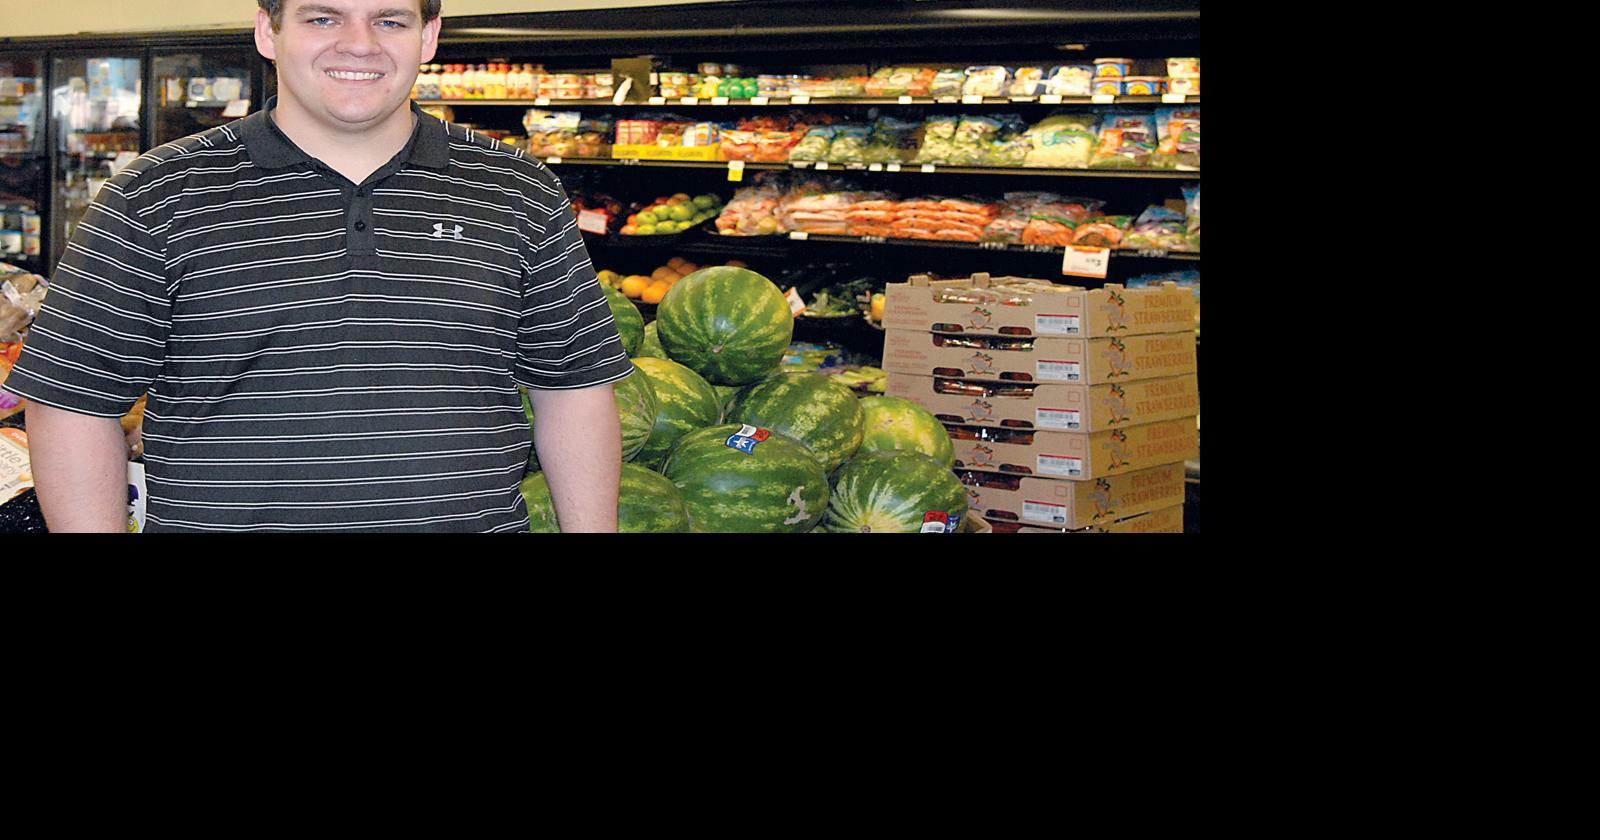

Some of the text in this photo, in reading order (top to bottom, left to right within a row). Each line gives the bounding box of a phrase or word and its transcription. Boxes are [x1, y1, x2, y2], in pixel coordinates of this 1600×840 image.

[1143, 294, 1183, 308] PREMIUM
[1133, 309, 1194, 325] STRAWBERRIES
[1144, 338, 1184, 353] PREMIUM
[1135, 352, 1194, 370] STRAWBERRIES
[1143, 381, 1185, 398] PREMIUM
[1135, 394, 1196, 416] STRAWBERRIES
